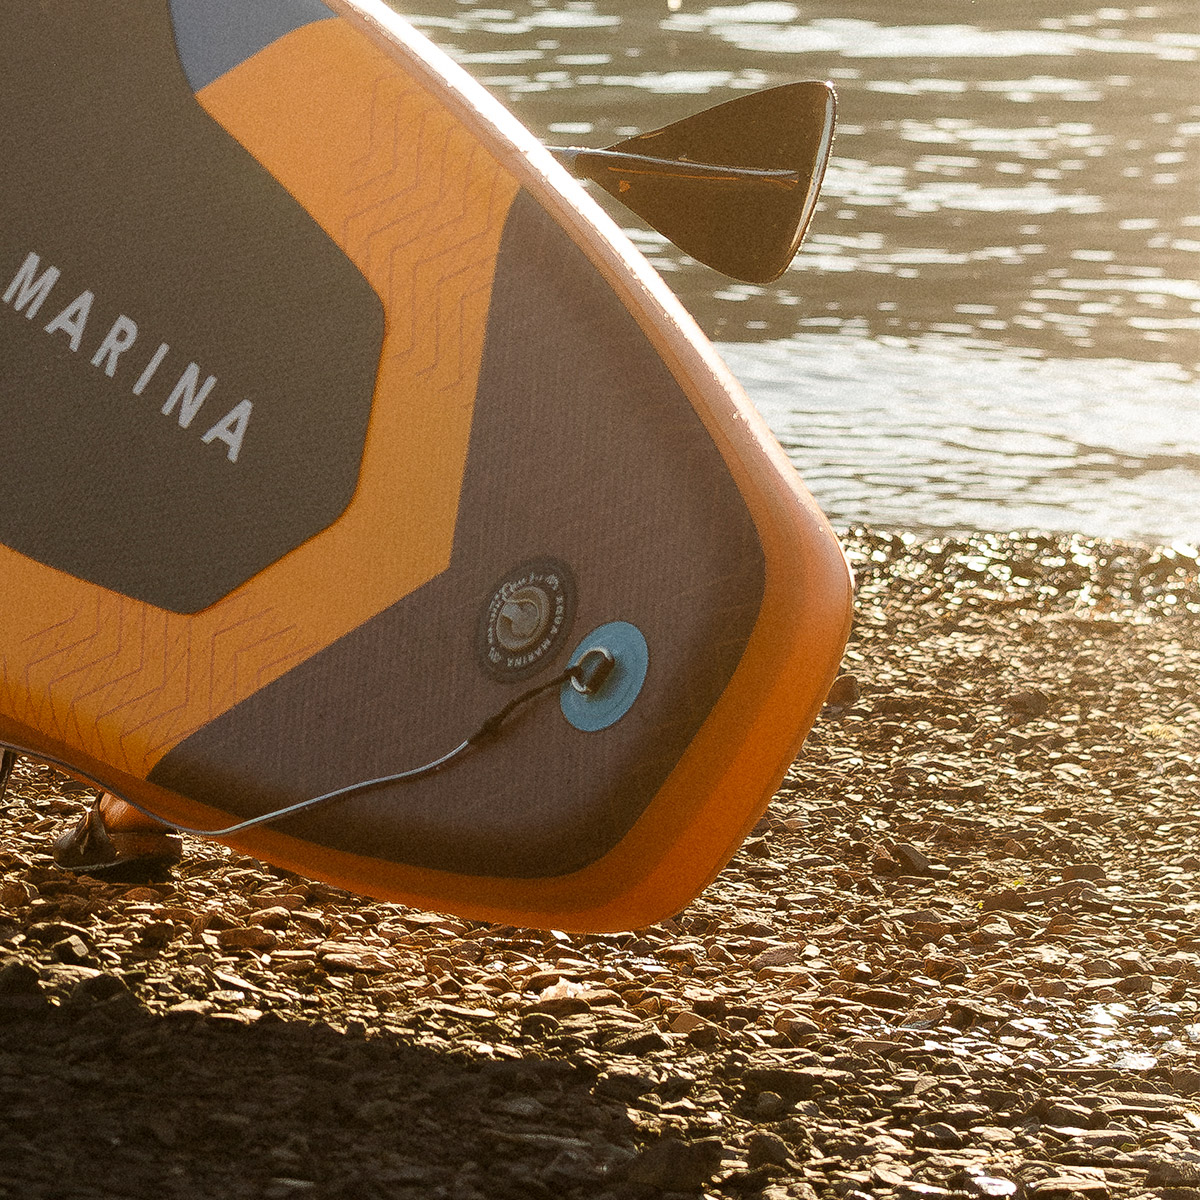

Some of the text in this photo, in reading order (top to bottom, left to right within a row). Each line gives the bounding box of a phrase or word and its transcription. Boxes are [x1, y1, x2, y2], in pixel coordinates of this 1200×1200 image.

[2, 251, 254, 464] MARINA
[550, 595, 564, 635] AQUA
[506, 638, 552, 667] MARINA
